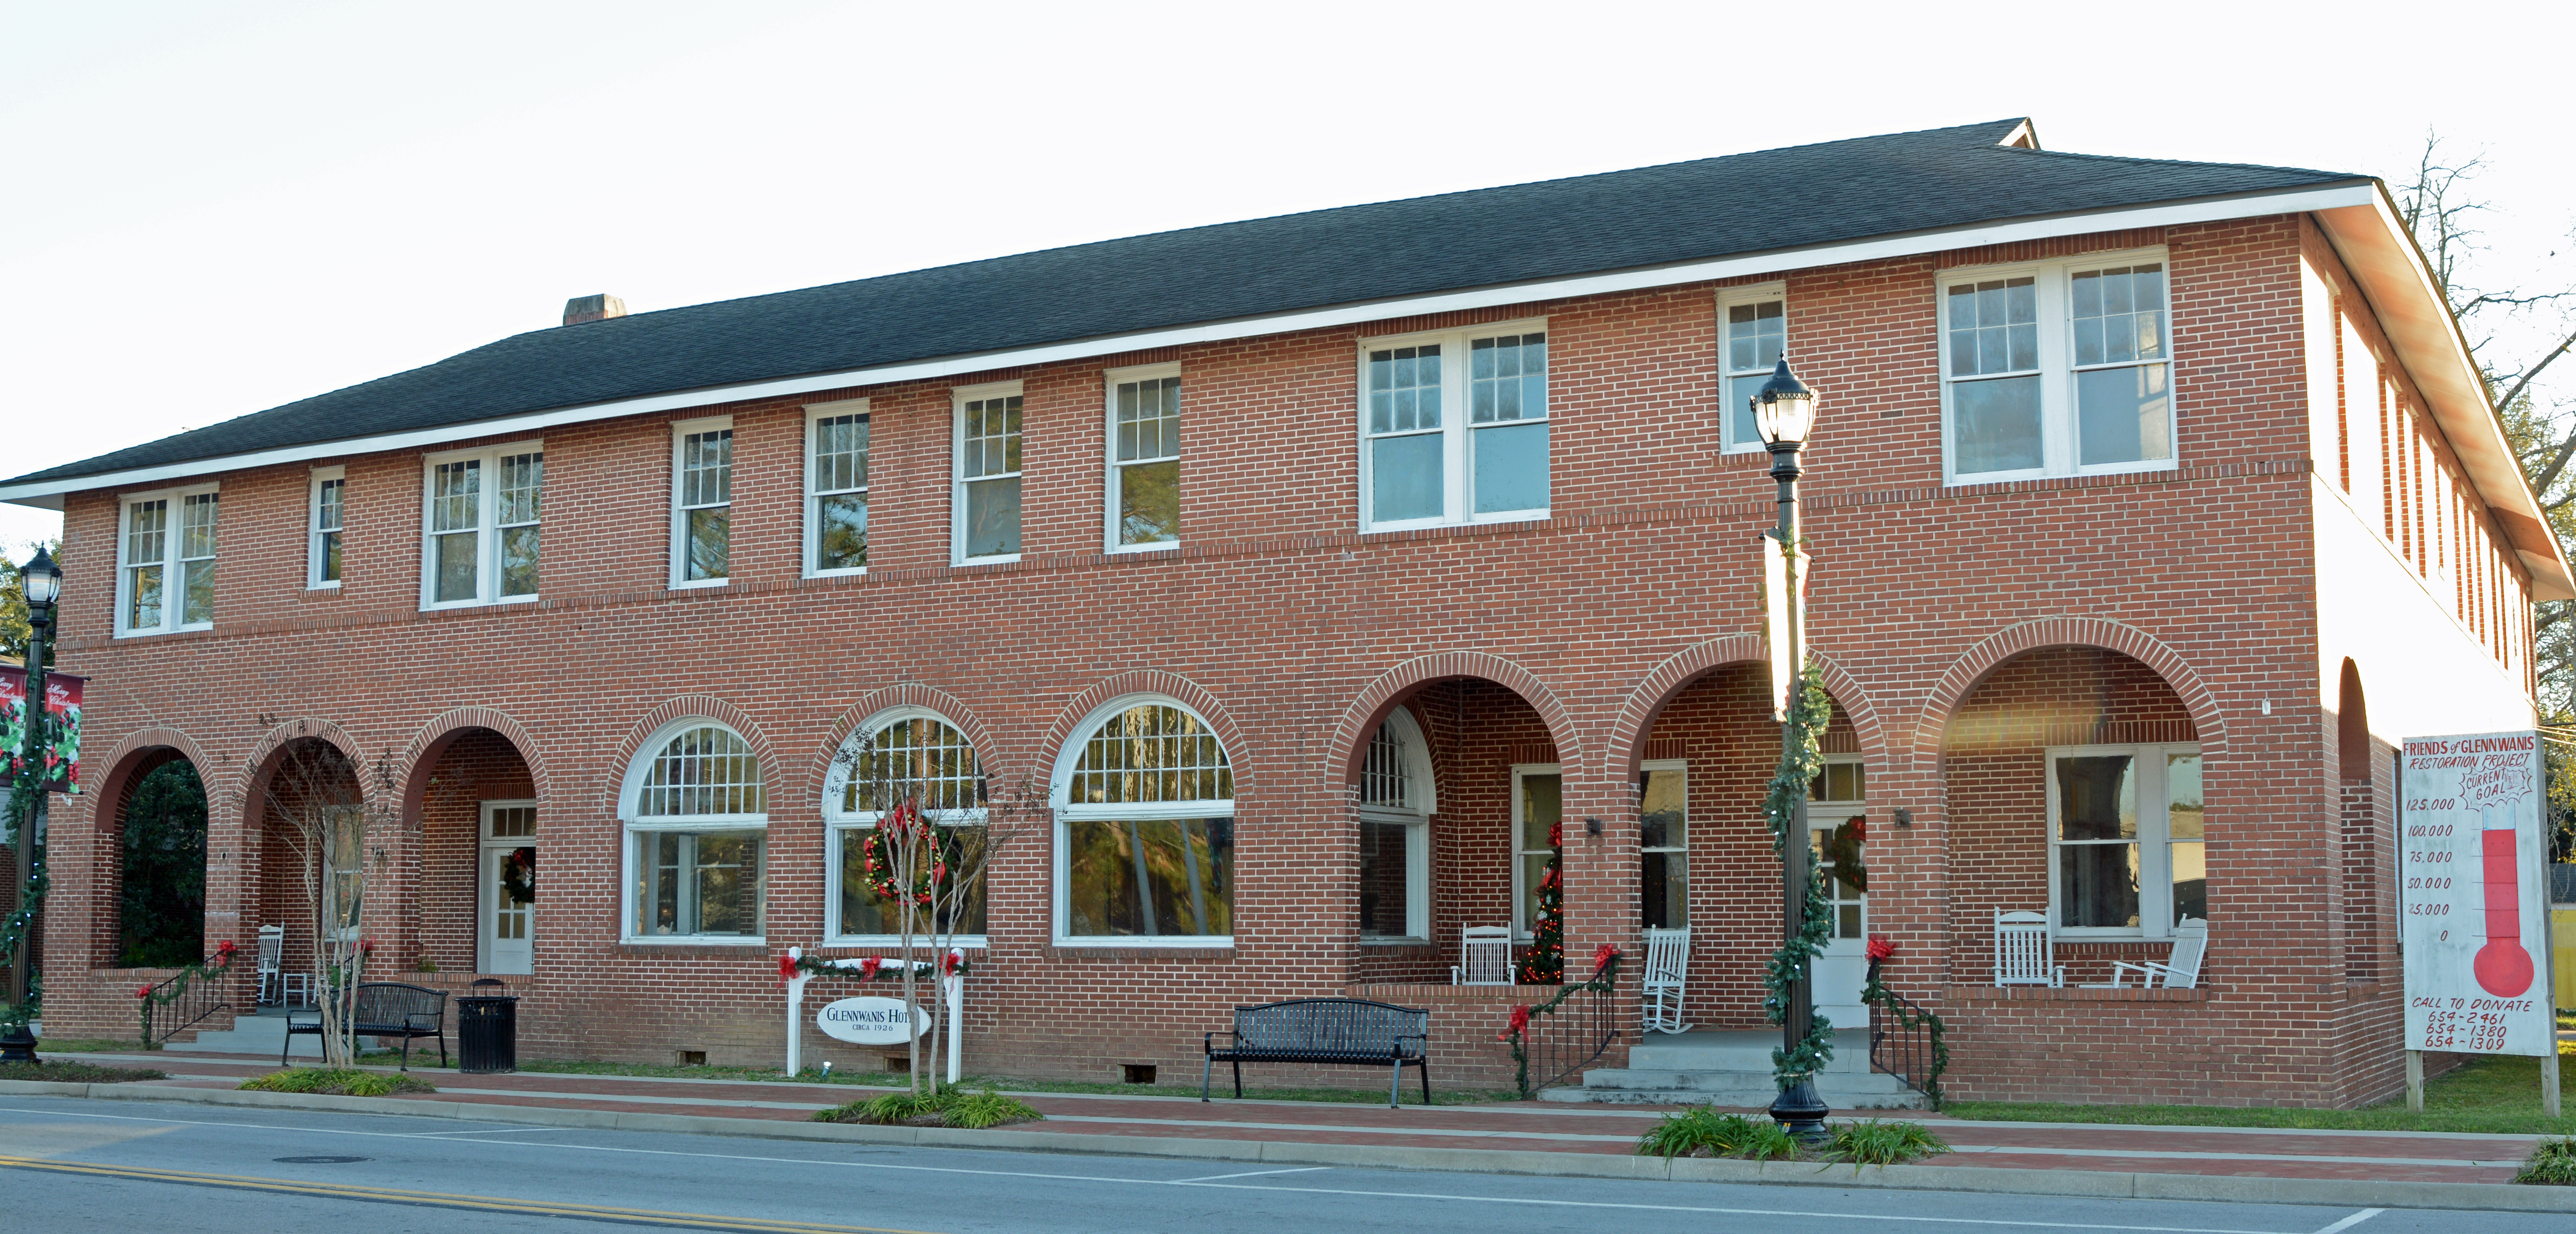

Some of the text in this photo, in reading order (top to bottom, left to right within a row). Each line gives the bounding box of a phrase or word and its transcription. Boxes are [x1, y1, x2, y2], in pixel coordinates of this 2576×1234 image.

[0, 689, 25, 700] hristmas
[46, 684, 70, 699] Merry
[49, 695, 80, 708] Christmas
[2403, 736, 2534, 756] FRIENDS of GLENNWANIS
[2409, 753, 2530, 770] RESTORATION PROJECT
[2467, 768, 2506, 789] CURRENT
[2476, 782, 2505, 800] GOAL
[2412, 997, 2533, 1012] CALL TO DONATE
[889, 1009, 911, 1023] HOT
[2428, 1011, 2505, 1025] 654-2461
